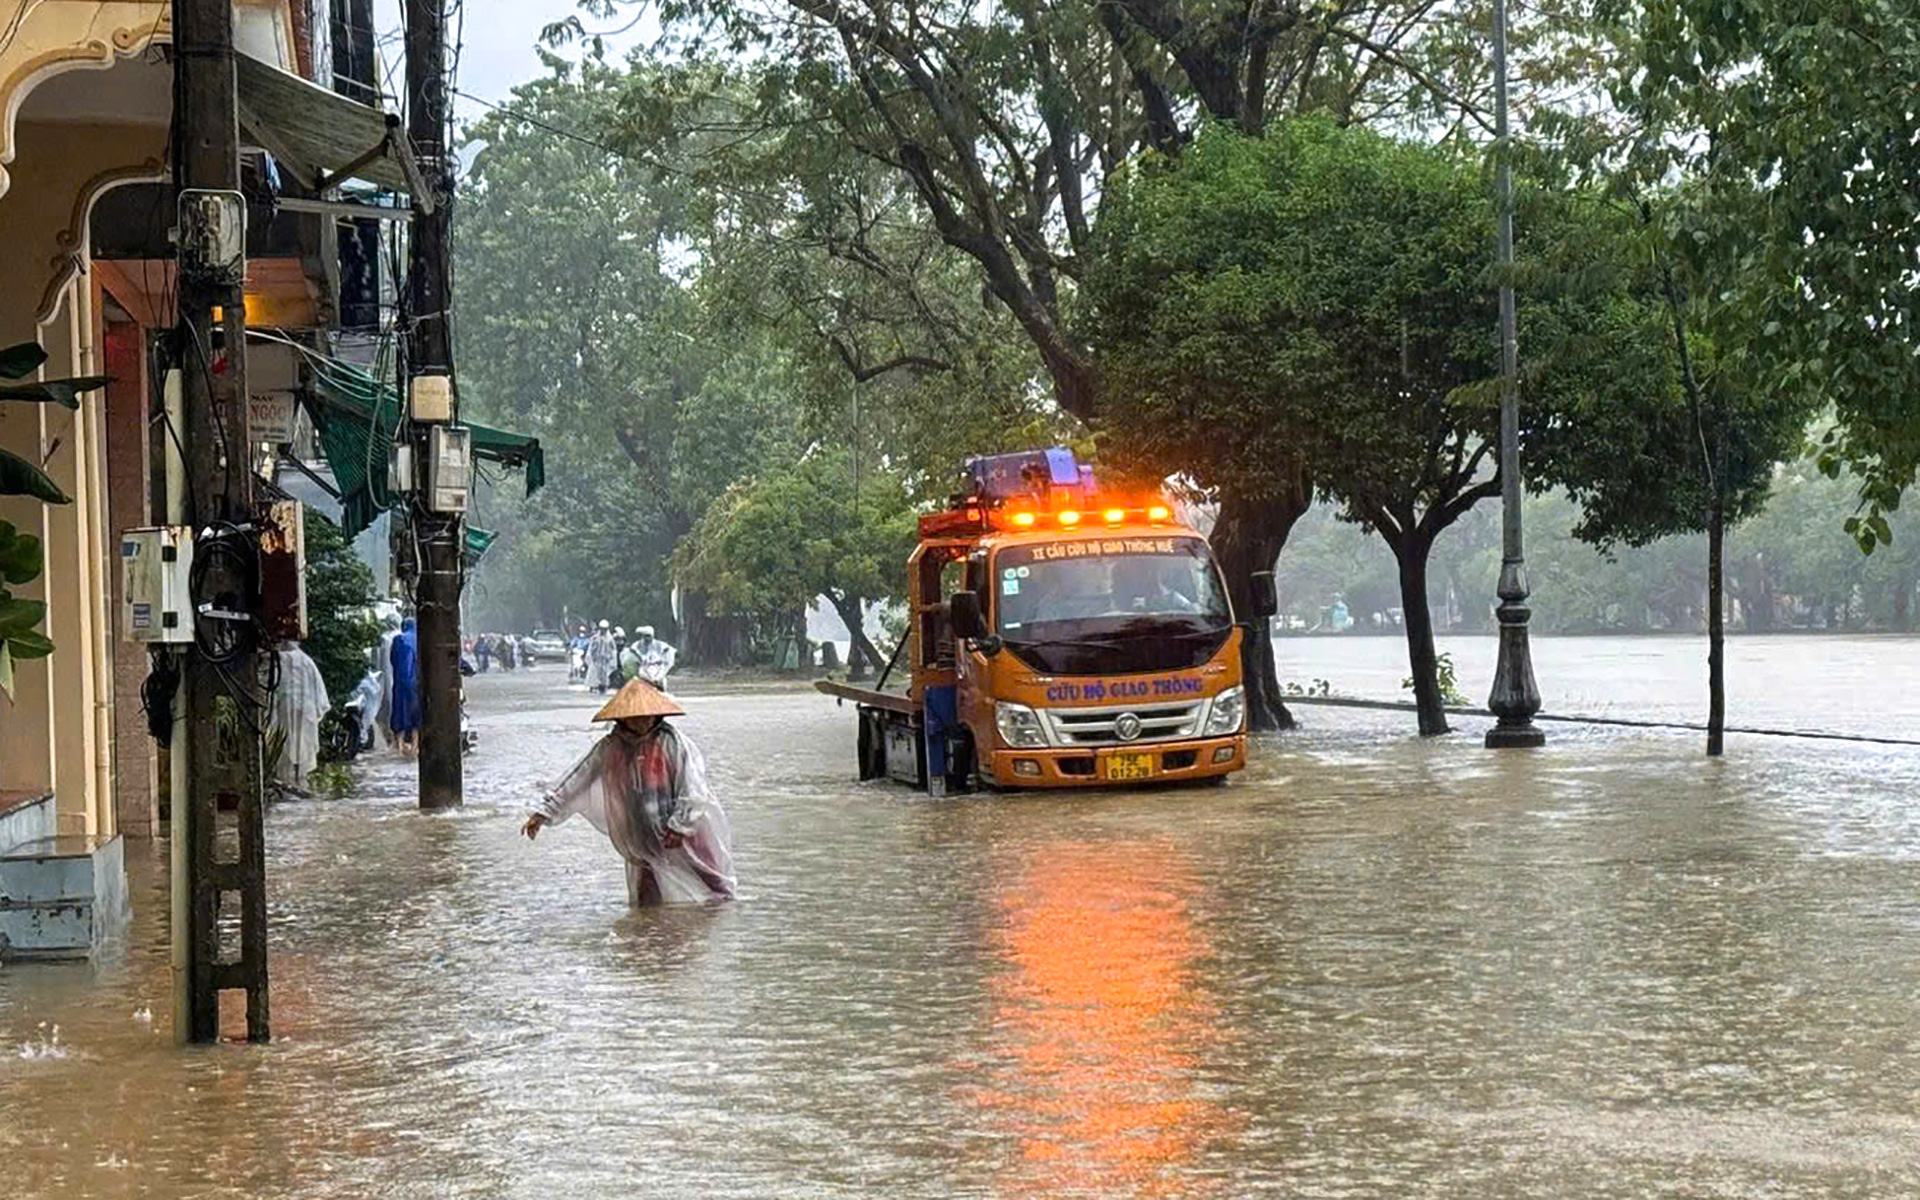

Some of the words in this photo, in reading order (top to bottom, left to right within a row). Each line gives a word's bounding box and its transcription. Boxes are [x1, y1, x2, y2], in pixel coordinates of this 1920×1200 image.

[1032, 546, 1045, 560] XE
[1103, 540, 1124, 553] GIAO
[1047, 682, 1079, 701] CỨU
[1084, 680, 1106, 700] HỘ
[1110, 681, 1149, 697] GIAO
[1153, 676, 1203, 695] THÔNG
